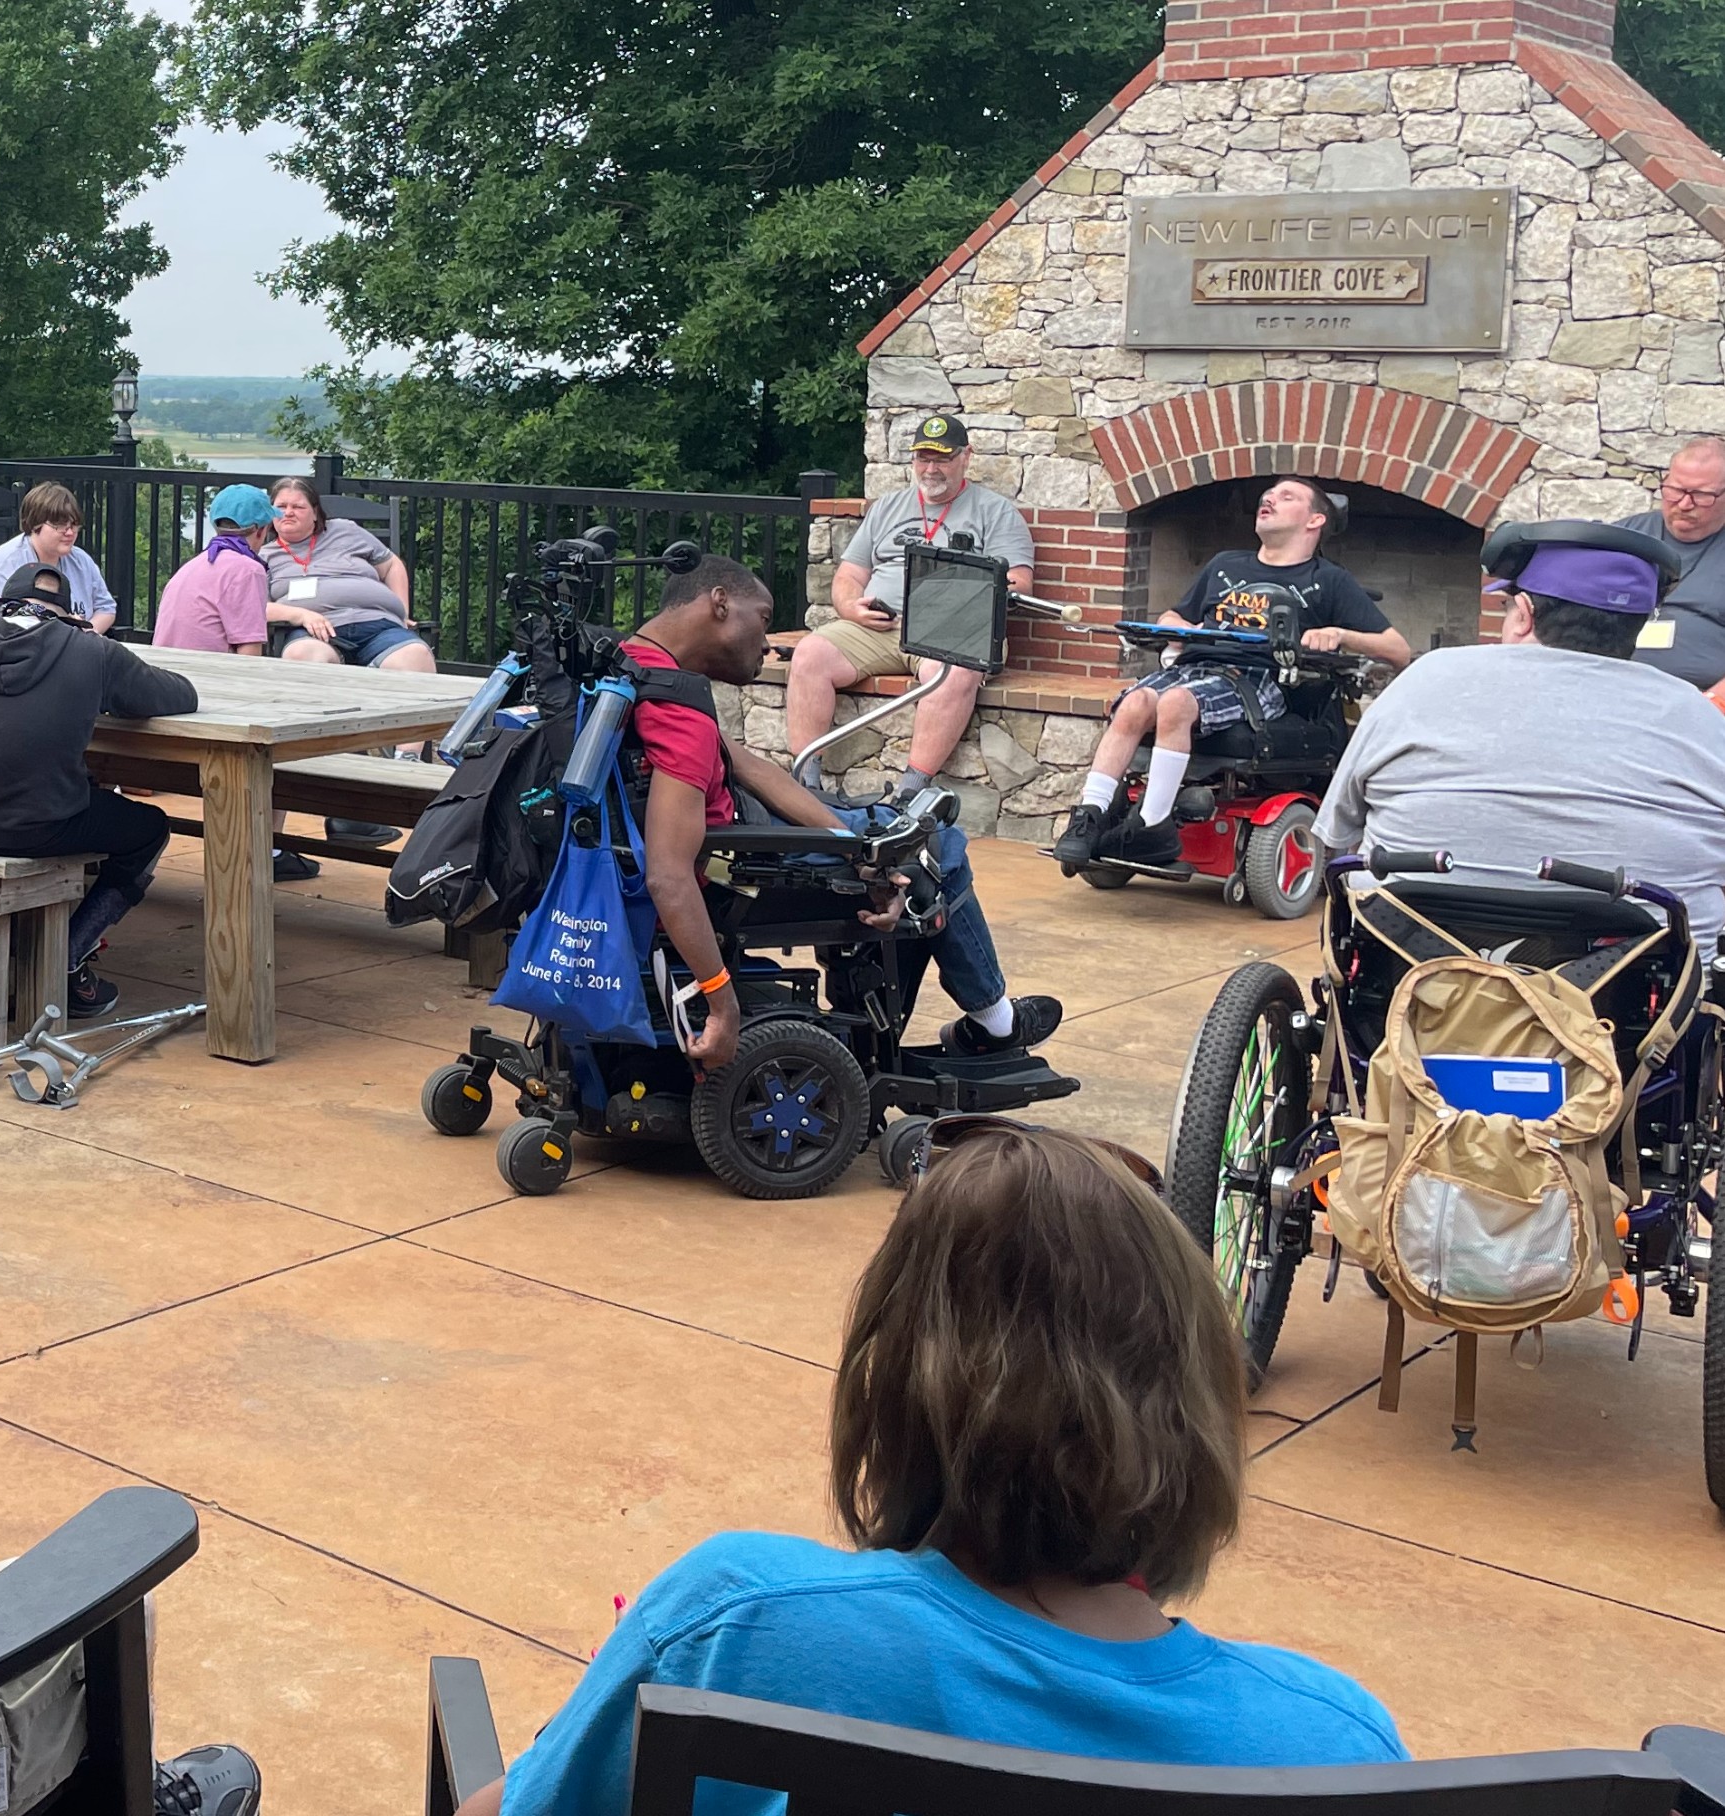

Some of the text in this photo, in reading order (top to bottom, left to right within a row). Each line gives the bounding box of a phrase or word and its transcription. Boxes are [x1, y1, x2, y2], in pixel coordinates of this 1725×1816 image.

[1143, 213, 1492, 246] NEW LIFE RANCH
[1227, 268, 1386, 292] FRONTIER COVE
[1222, 590, 1270, 609] ARM
[550, 908, 608, 933] Waington
[549, 948, 596, 970] Reunion
[521, 960, 552, 982] June
[553, 969, 563, 984] 6
[587, 974, 622, 991] 2014
